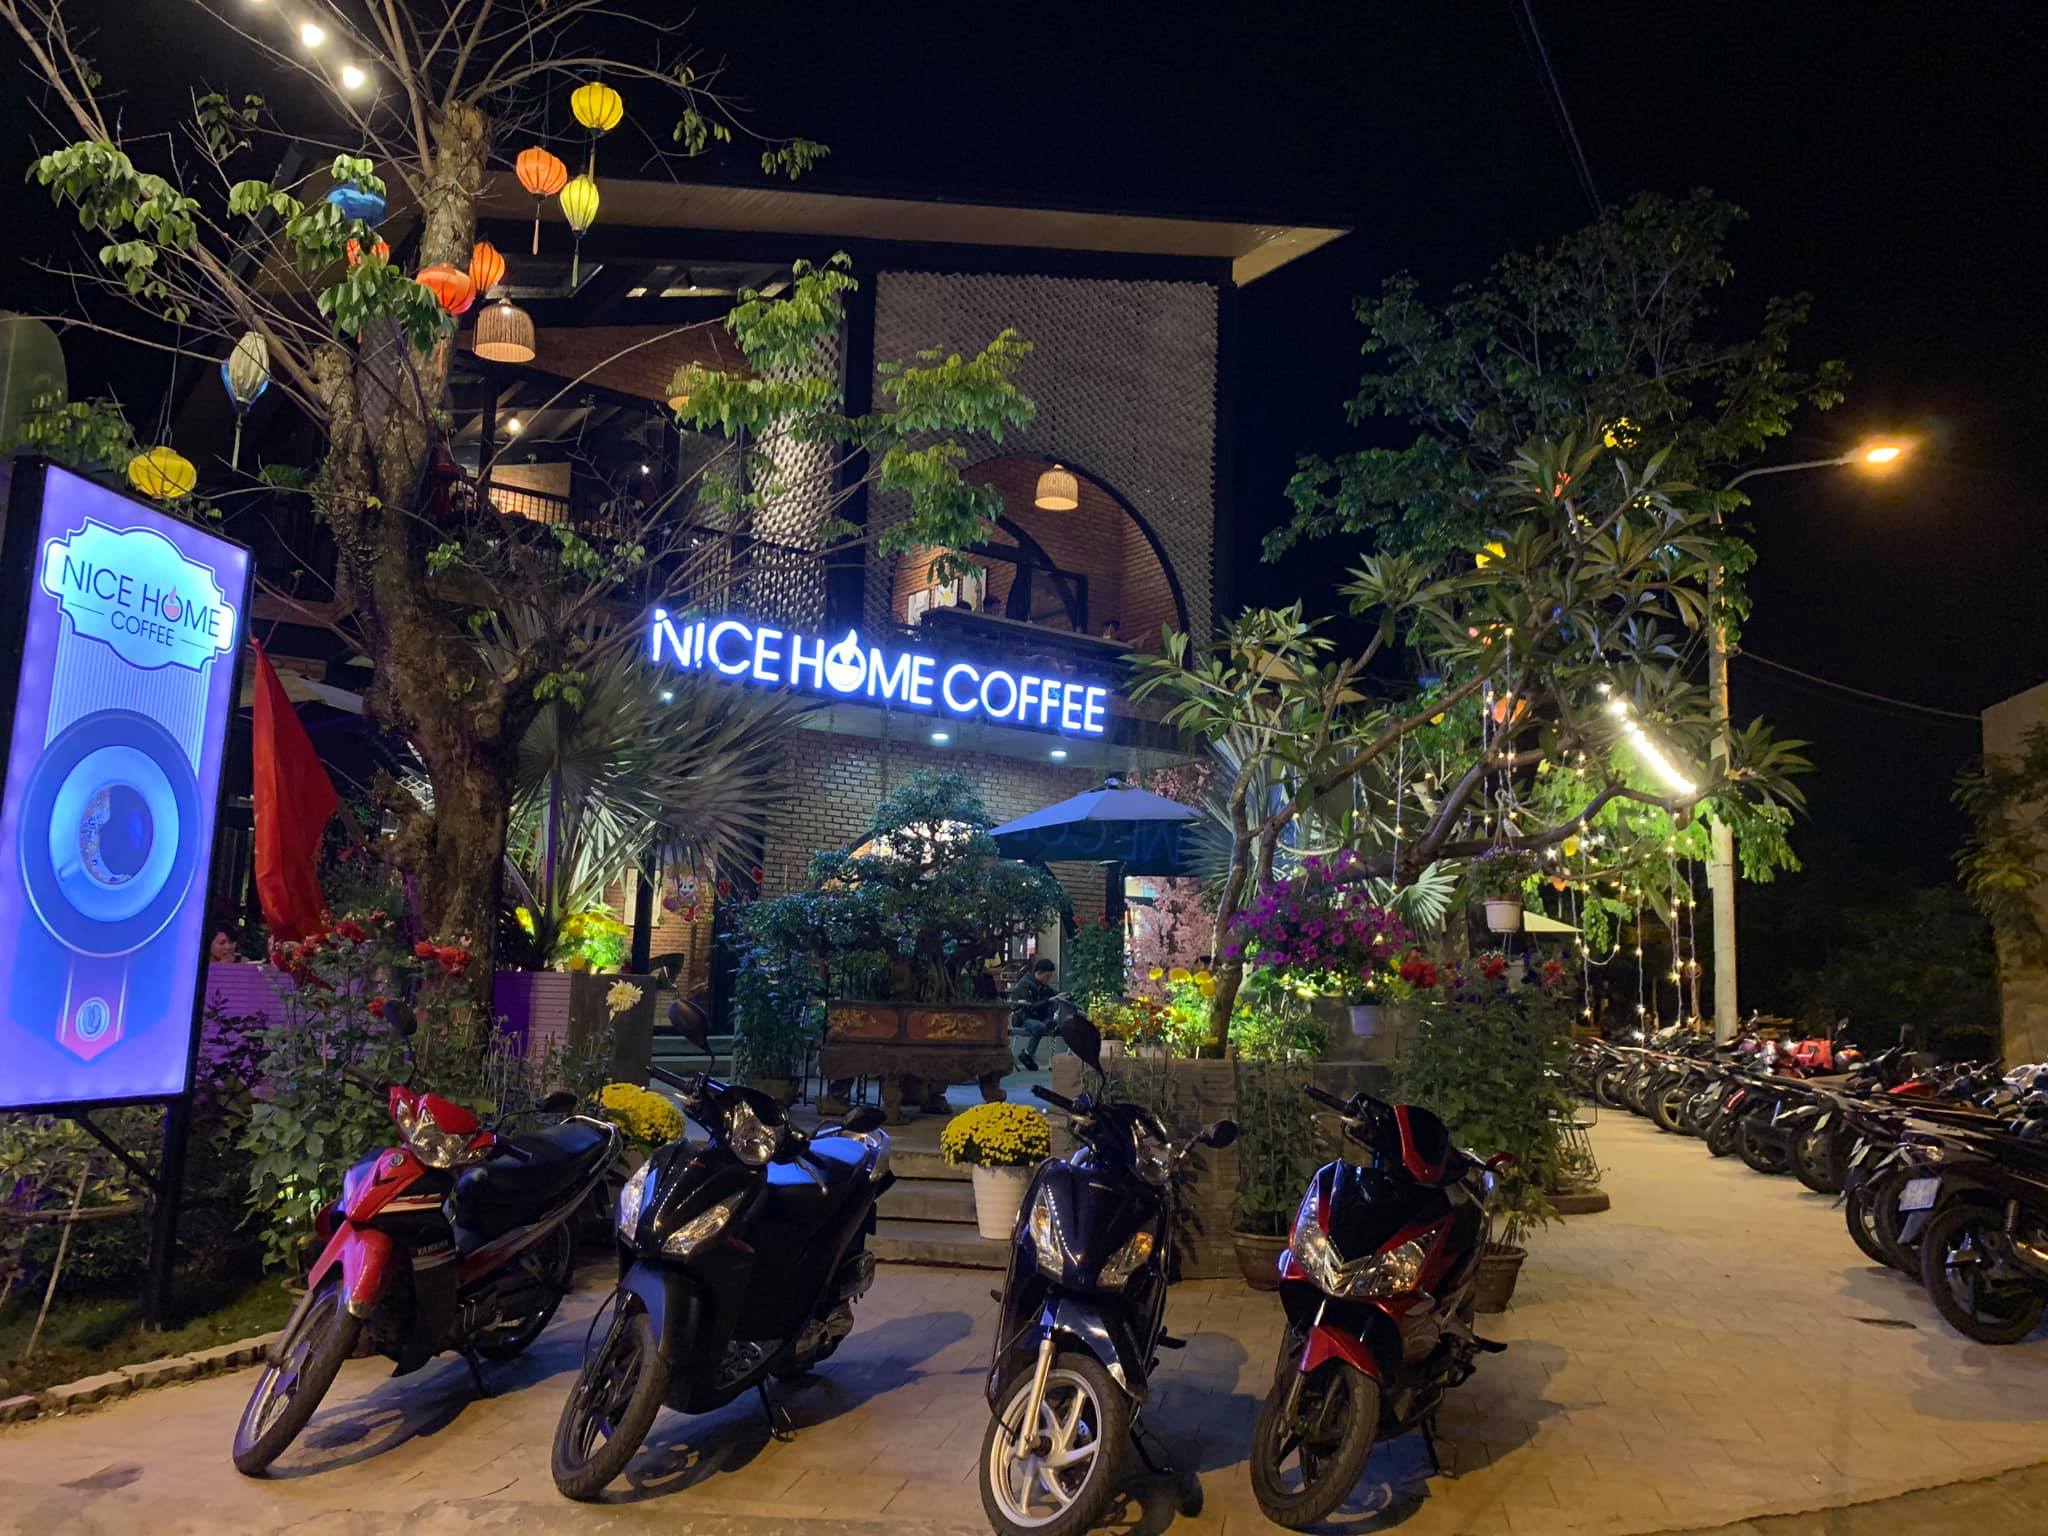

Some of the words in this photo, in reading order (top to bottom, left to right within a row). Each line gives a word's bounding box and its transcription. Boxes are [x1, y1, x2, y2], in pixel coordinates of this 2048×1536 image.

[62, 554, 134, 608] NICE
[141, 583, 222, 638] HOME
[110, 610, 176, 647] COFFEE
[651, 609, 781, 682] NICE
[790, 634, 935, 706] HOME
[942, 663, 1107, 733] COFFEE
